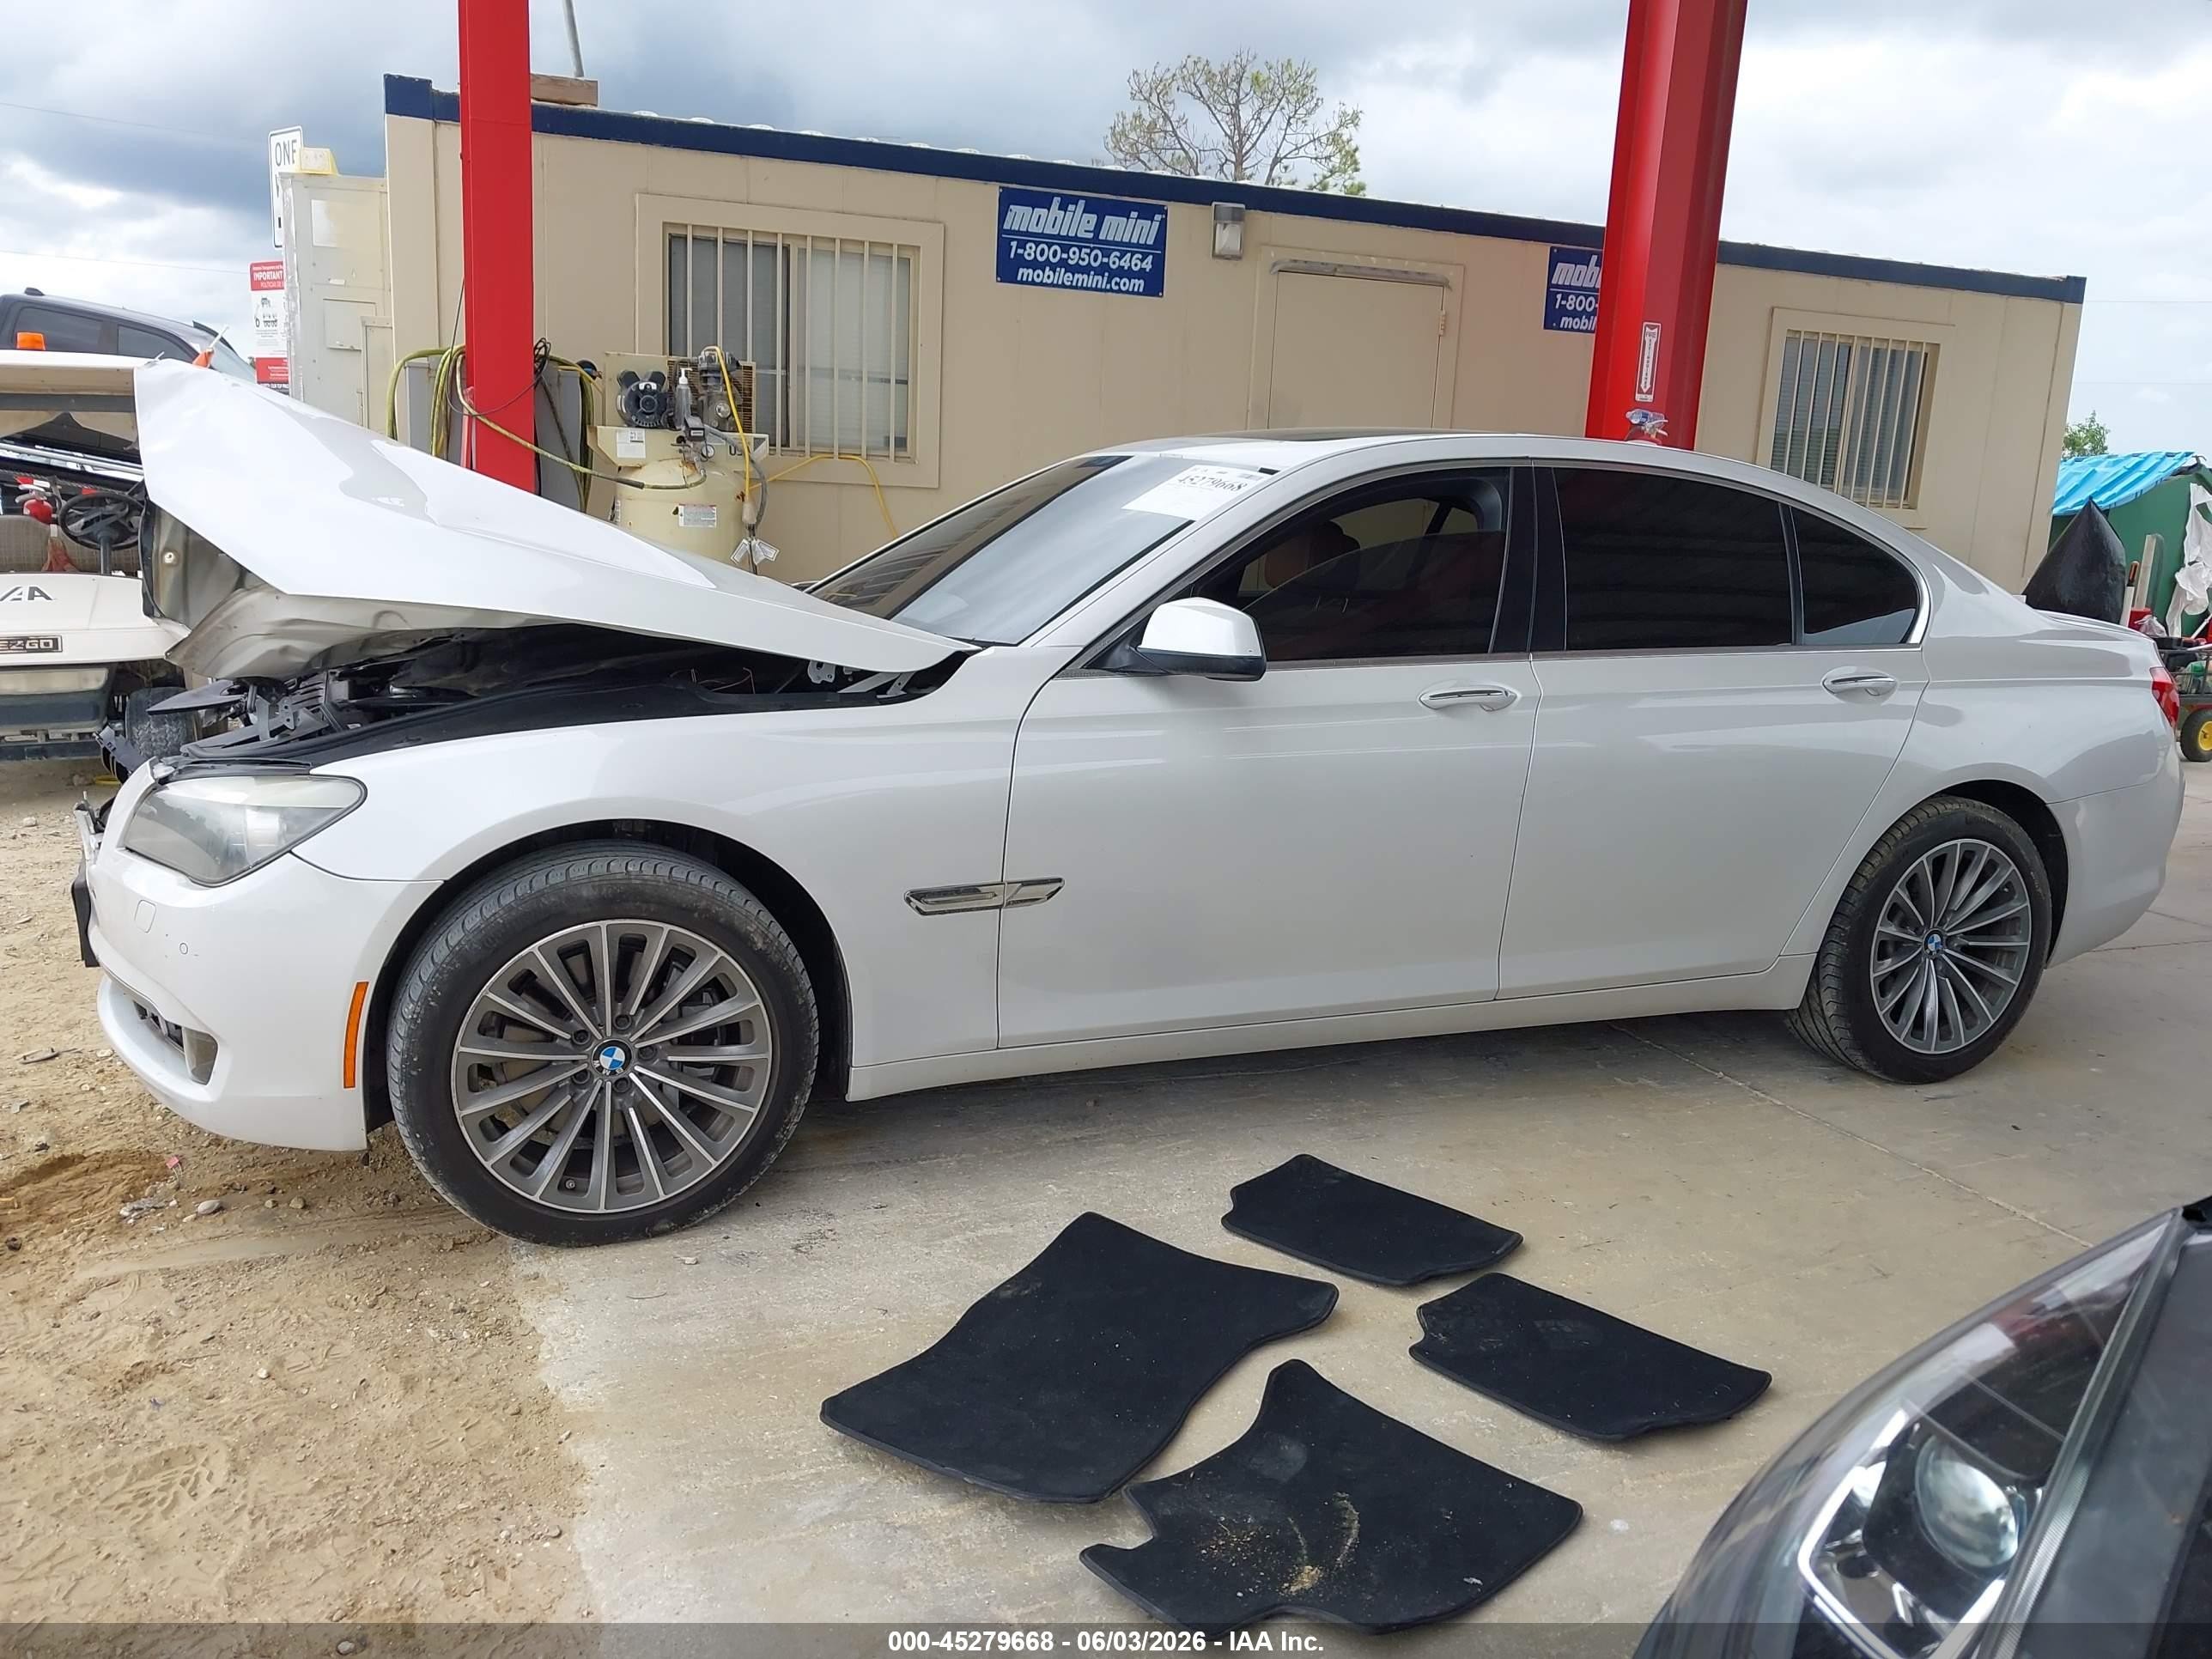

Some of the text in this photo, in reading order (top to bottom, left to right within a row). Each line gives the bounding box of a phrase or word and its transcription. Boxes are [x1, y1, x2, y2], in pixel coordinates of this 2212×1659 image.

[275, 139, 297, 167] ONE
[1003, 197, 1162, 246] mobile mini
[1009, 240, 1153, 272] 1-800-950-6464
[252, 270, 283, 282] IMPORTANT
[1017, 266, 1146, 293] mobilemini.com
